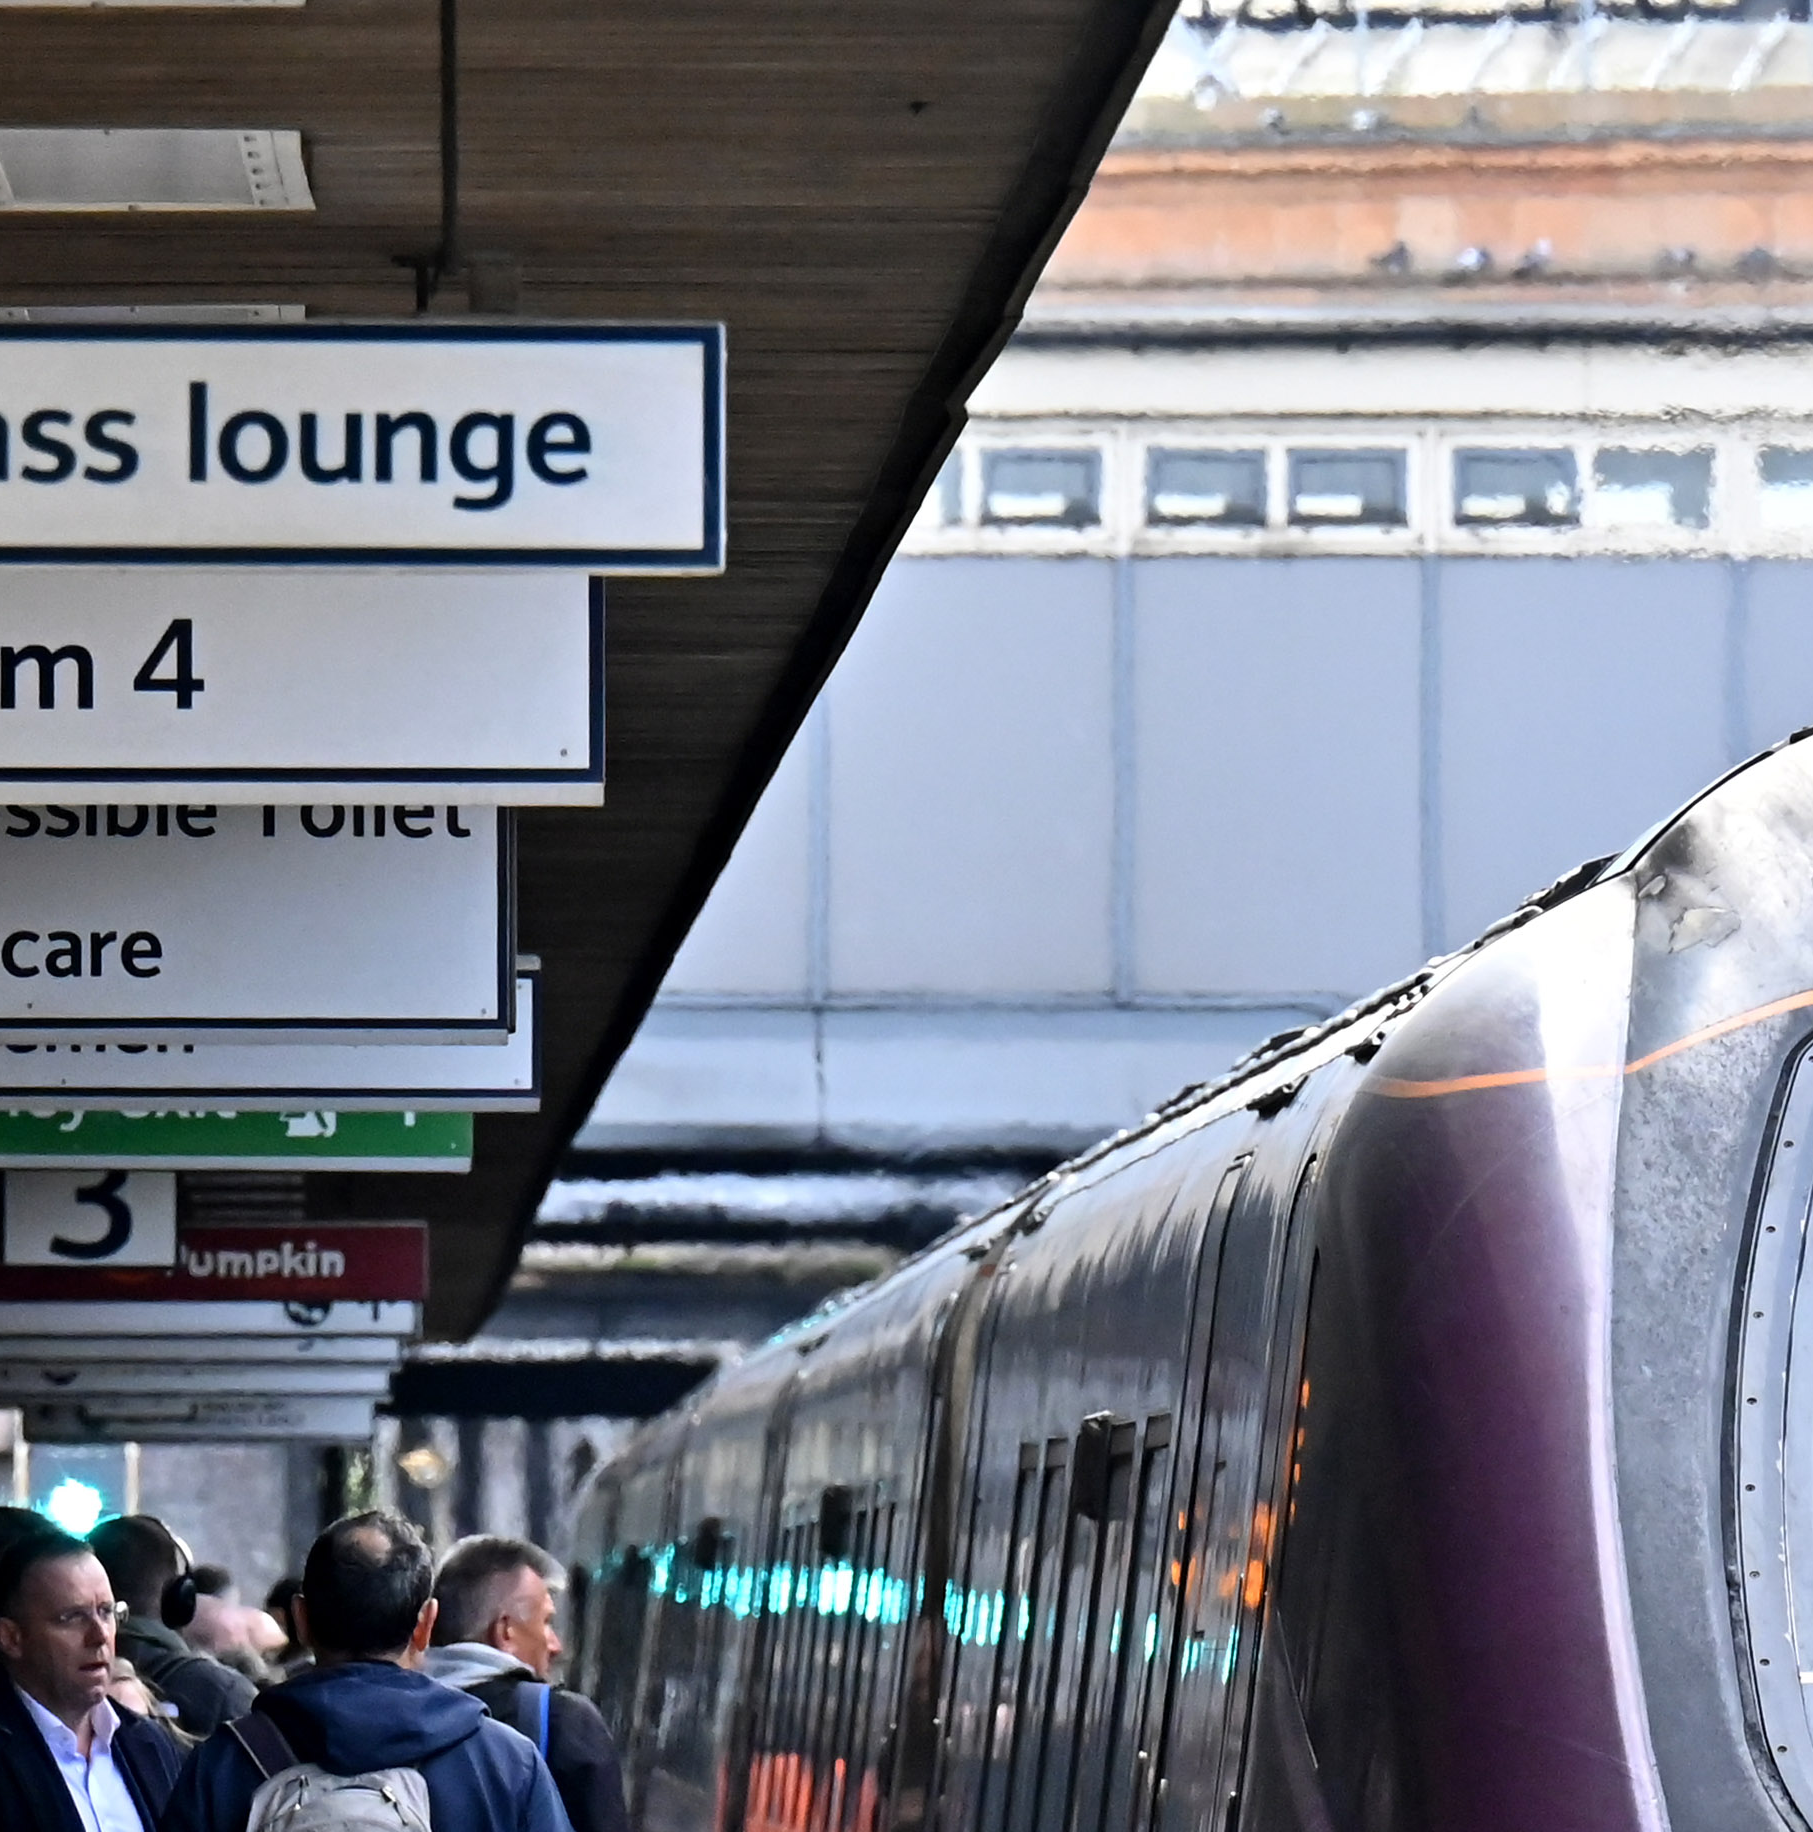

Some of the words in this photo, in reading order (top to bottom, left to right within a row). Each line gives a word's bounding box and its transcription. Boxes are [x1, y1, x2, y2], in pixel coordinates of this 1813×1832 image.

[188, 380, 593, 513] lounge
[132, 619, 205, 709] 4
[47, 1171, 134, 1260] 3
[180, 1242, 347, 1280] umpkin
